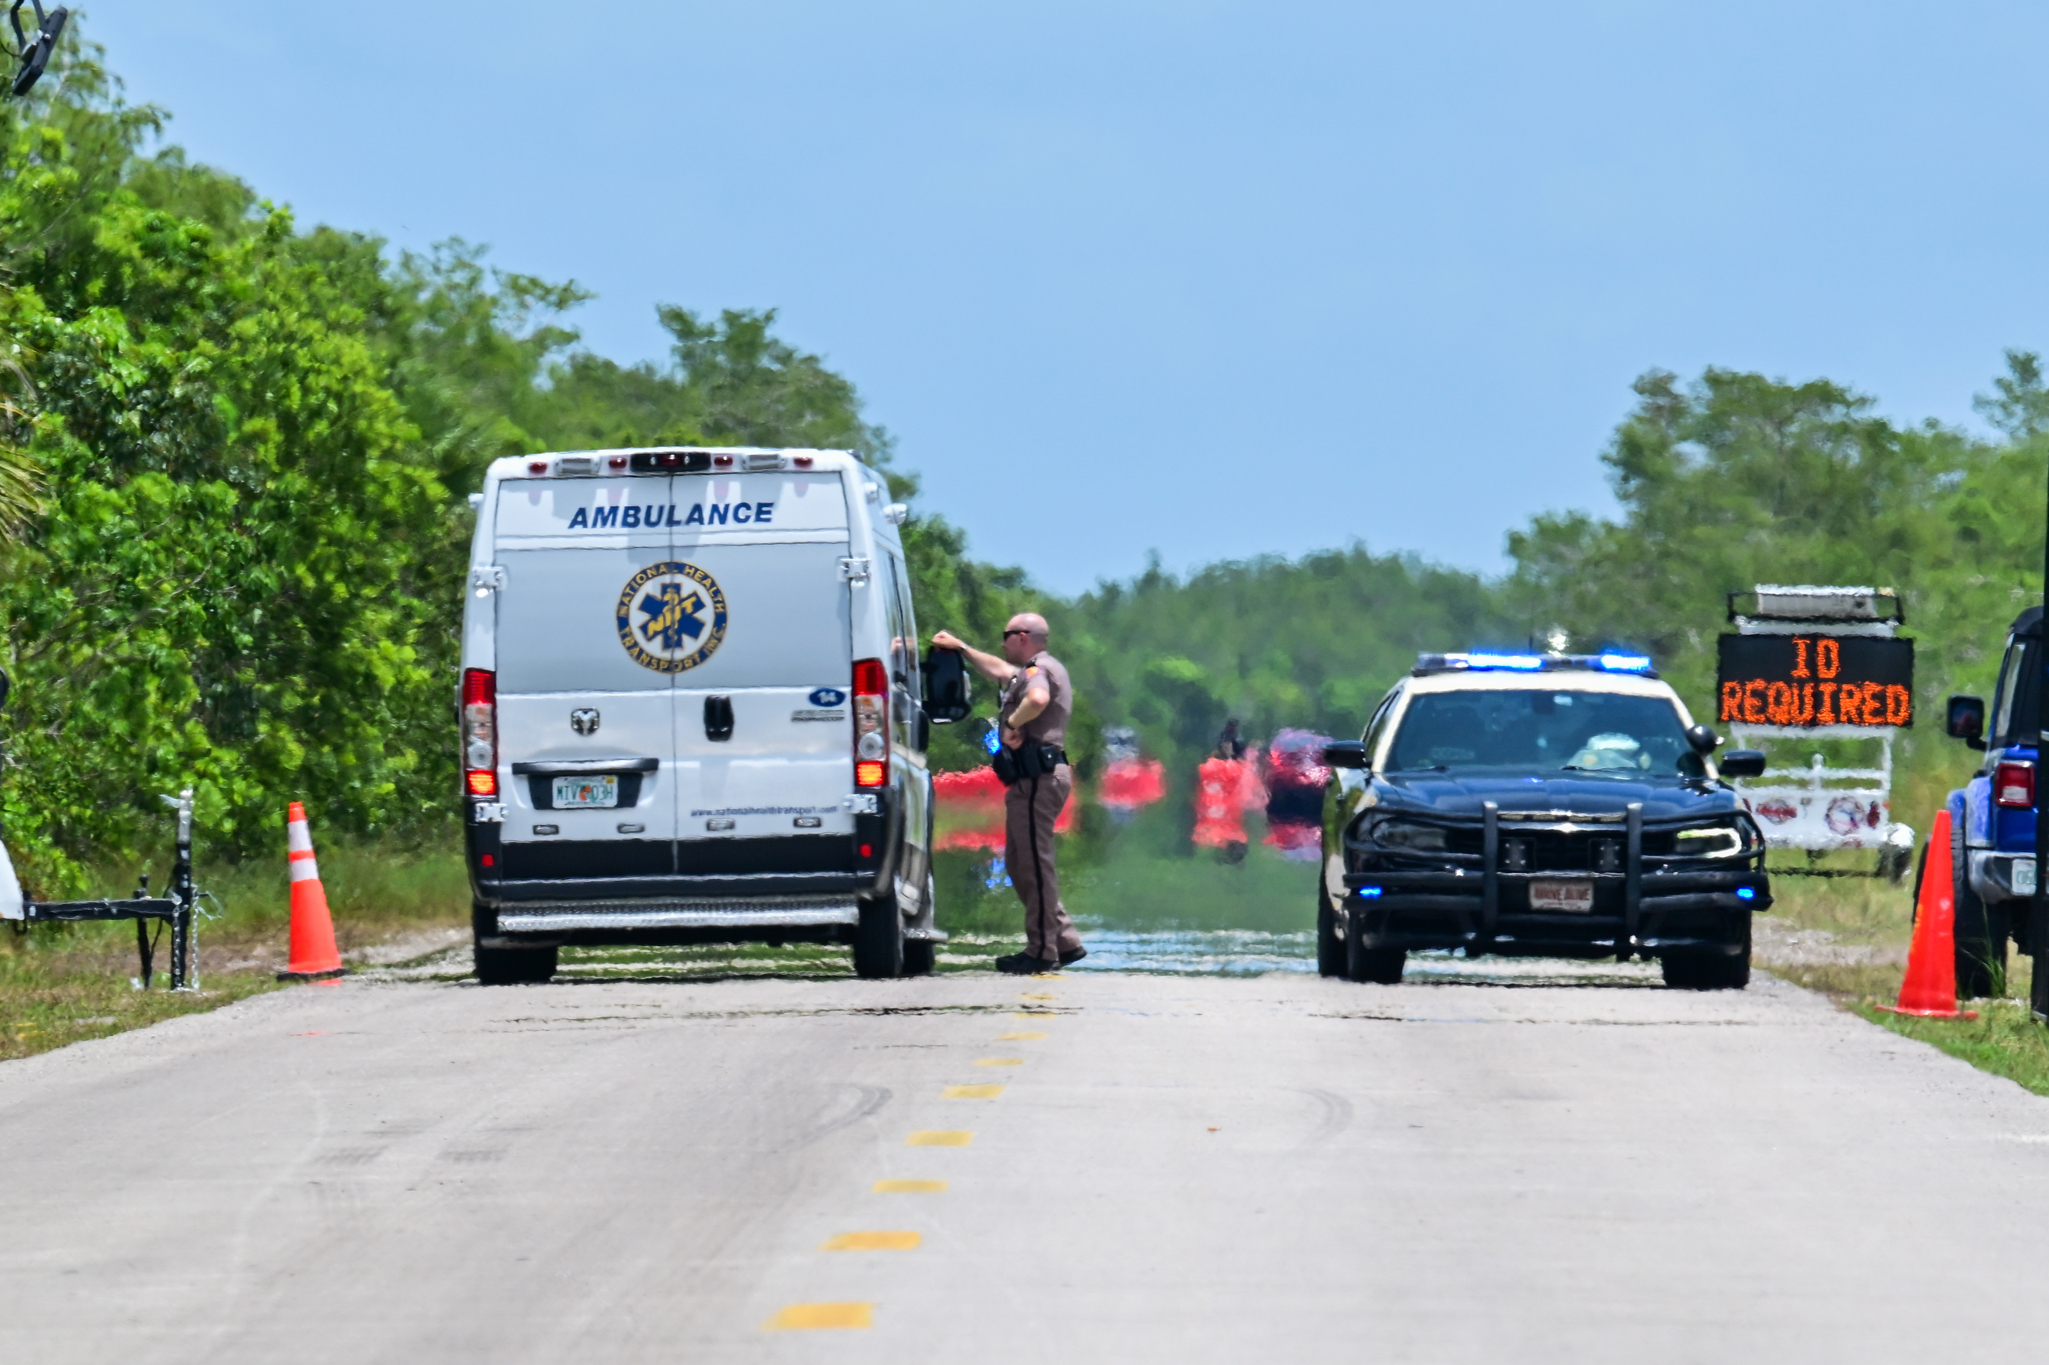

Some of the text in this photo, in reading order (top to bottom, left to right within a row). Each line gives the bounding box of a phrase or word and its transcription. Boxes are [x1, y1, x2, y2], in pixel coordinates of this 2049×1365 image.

[568, 502, 774, 529] AMBULANCE
[684, 565, 725, 613] HEALTH
[1791, 636, 1841, 679] ID
[1720, 679, 1911, 726] REQUIRED
